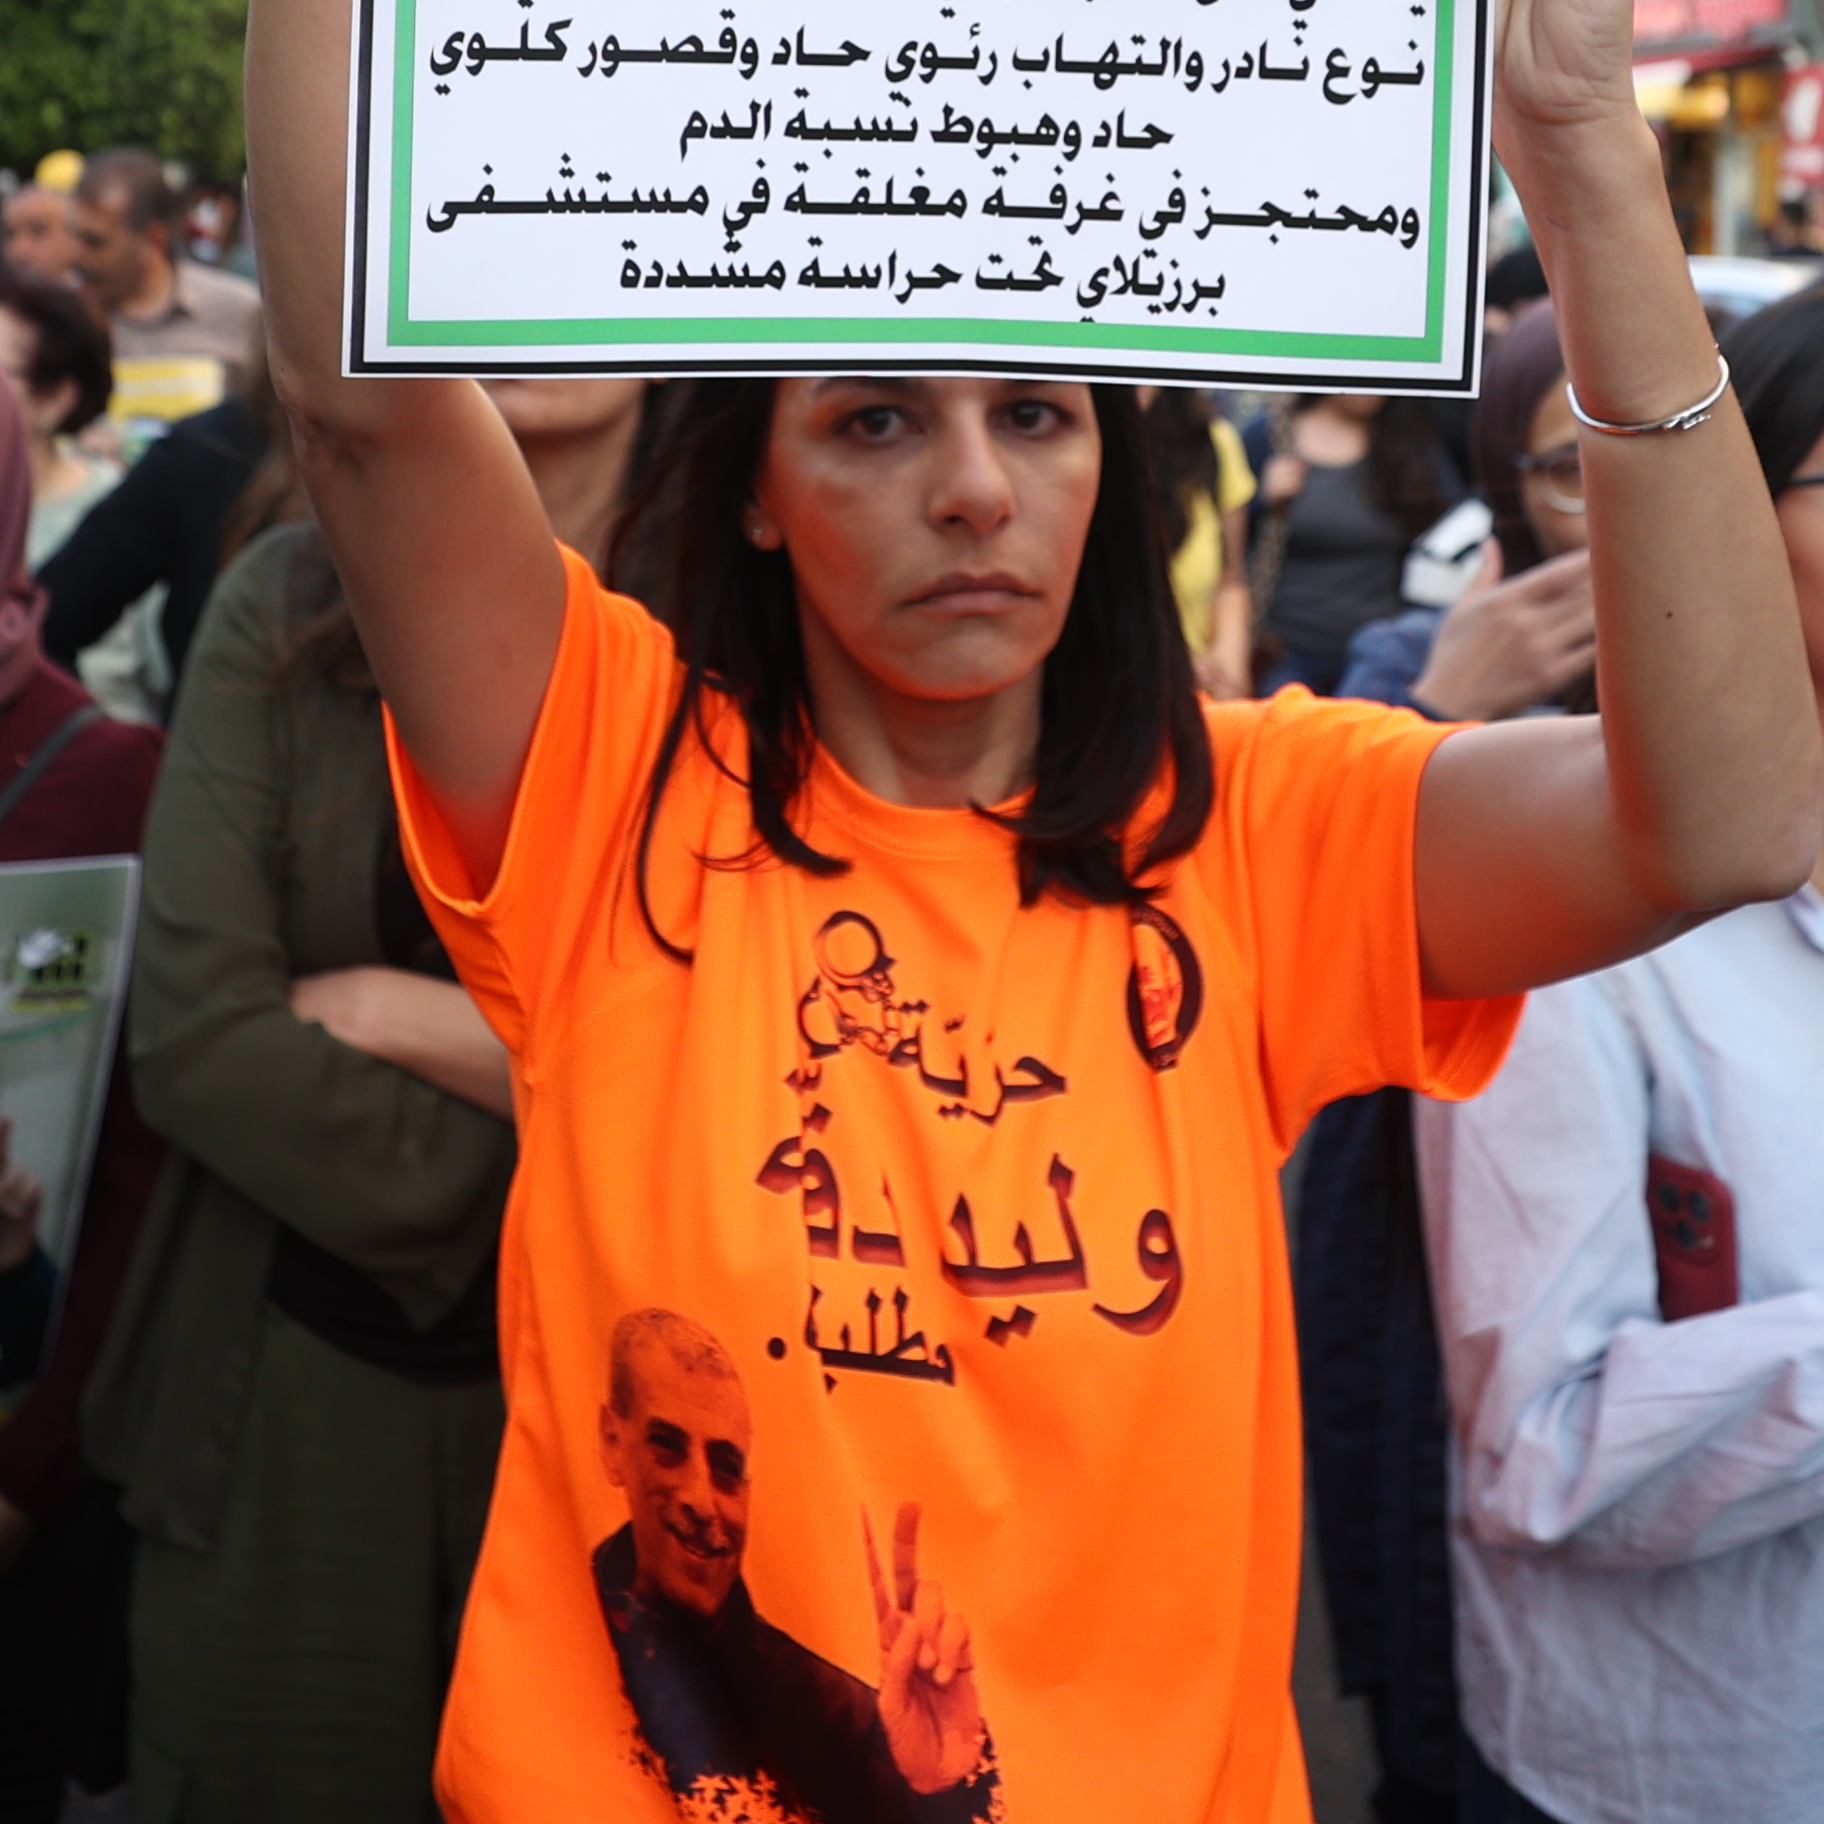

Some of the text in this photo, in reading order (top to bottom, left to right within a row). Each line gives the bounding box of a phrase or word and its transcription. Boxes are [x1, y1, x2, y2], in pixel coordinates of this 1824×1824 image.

[430, 9, 1425, 104] نوع نادر والتهاب رئوي حاد وقصور كلوي
[680, 88, 1175, 163] حاد وهبوط نسبة الدم
[427, 152, 709, 233] مستشفى
[784, 161, 967, 217] مغلقة
[981, 164, 1124, 234] غرفة
[1193, 186, 1420, 249] ومحتجز
[620, 230, 1225, 323] برزيلاي تحت حراسة مشددة
[941, 1152, 1182, 1348] وليد
